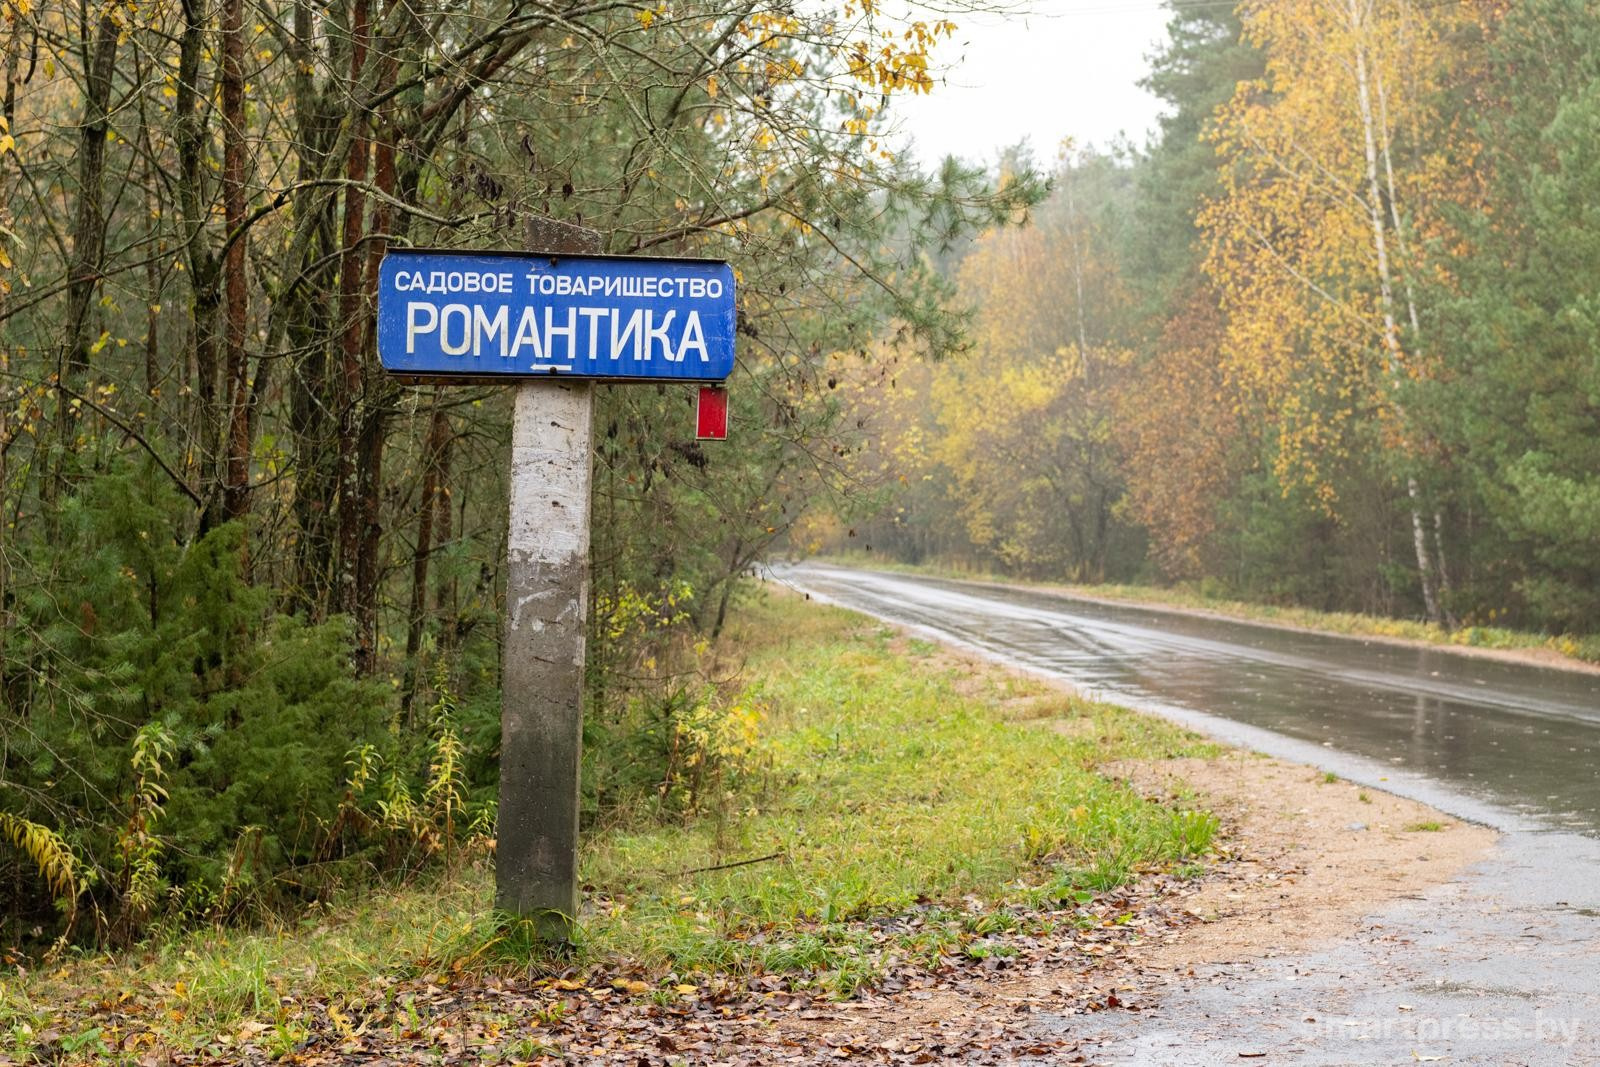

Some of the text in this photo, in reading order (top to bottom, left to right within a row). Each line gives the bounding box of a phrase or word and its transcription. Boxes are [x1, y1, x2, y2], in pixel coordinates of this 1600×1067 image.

[395, 271, 723, 298] САДОВОЕ ТОВАРИЩЕСТВО
[406, 302, 709, 362] РОМАНТИКА
